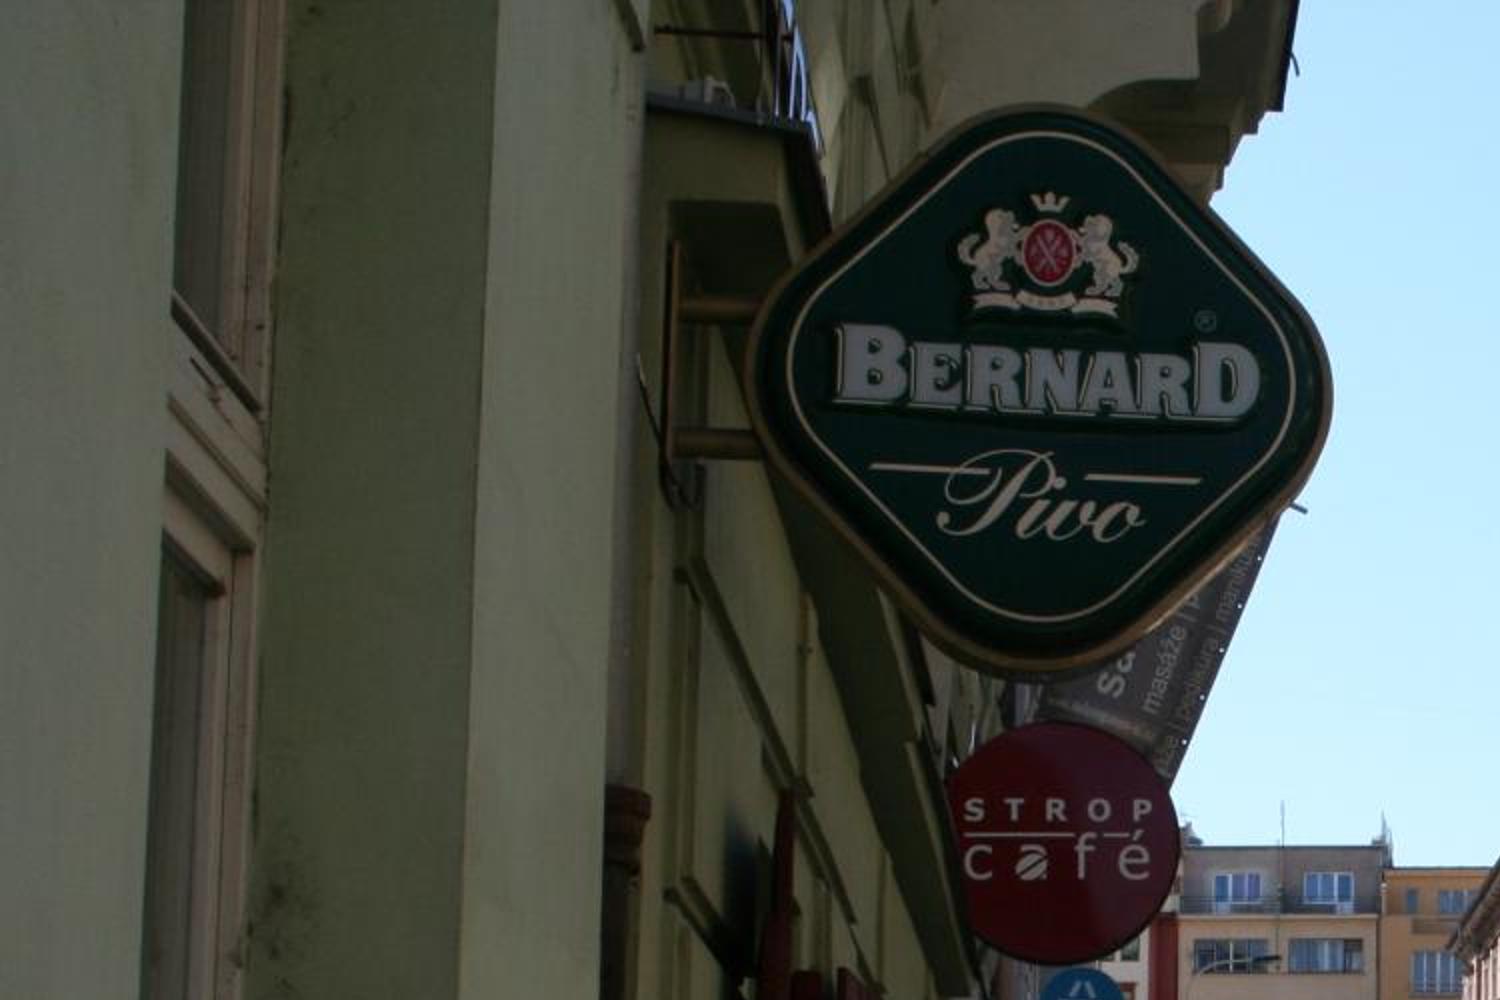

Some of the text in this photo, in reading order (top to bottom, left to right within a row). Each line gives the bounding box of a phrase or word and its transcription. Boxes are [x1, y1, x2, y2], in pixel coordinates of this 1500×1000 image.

[832, 322, 1261, 421] BERNARD
[936, 448, 1145, 543] Pivo
[963, 797, 1152, 823] STROP
[963, 829, 1151, 881] café
